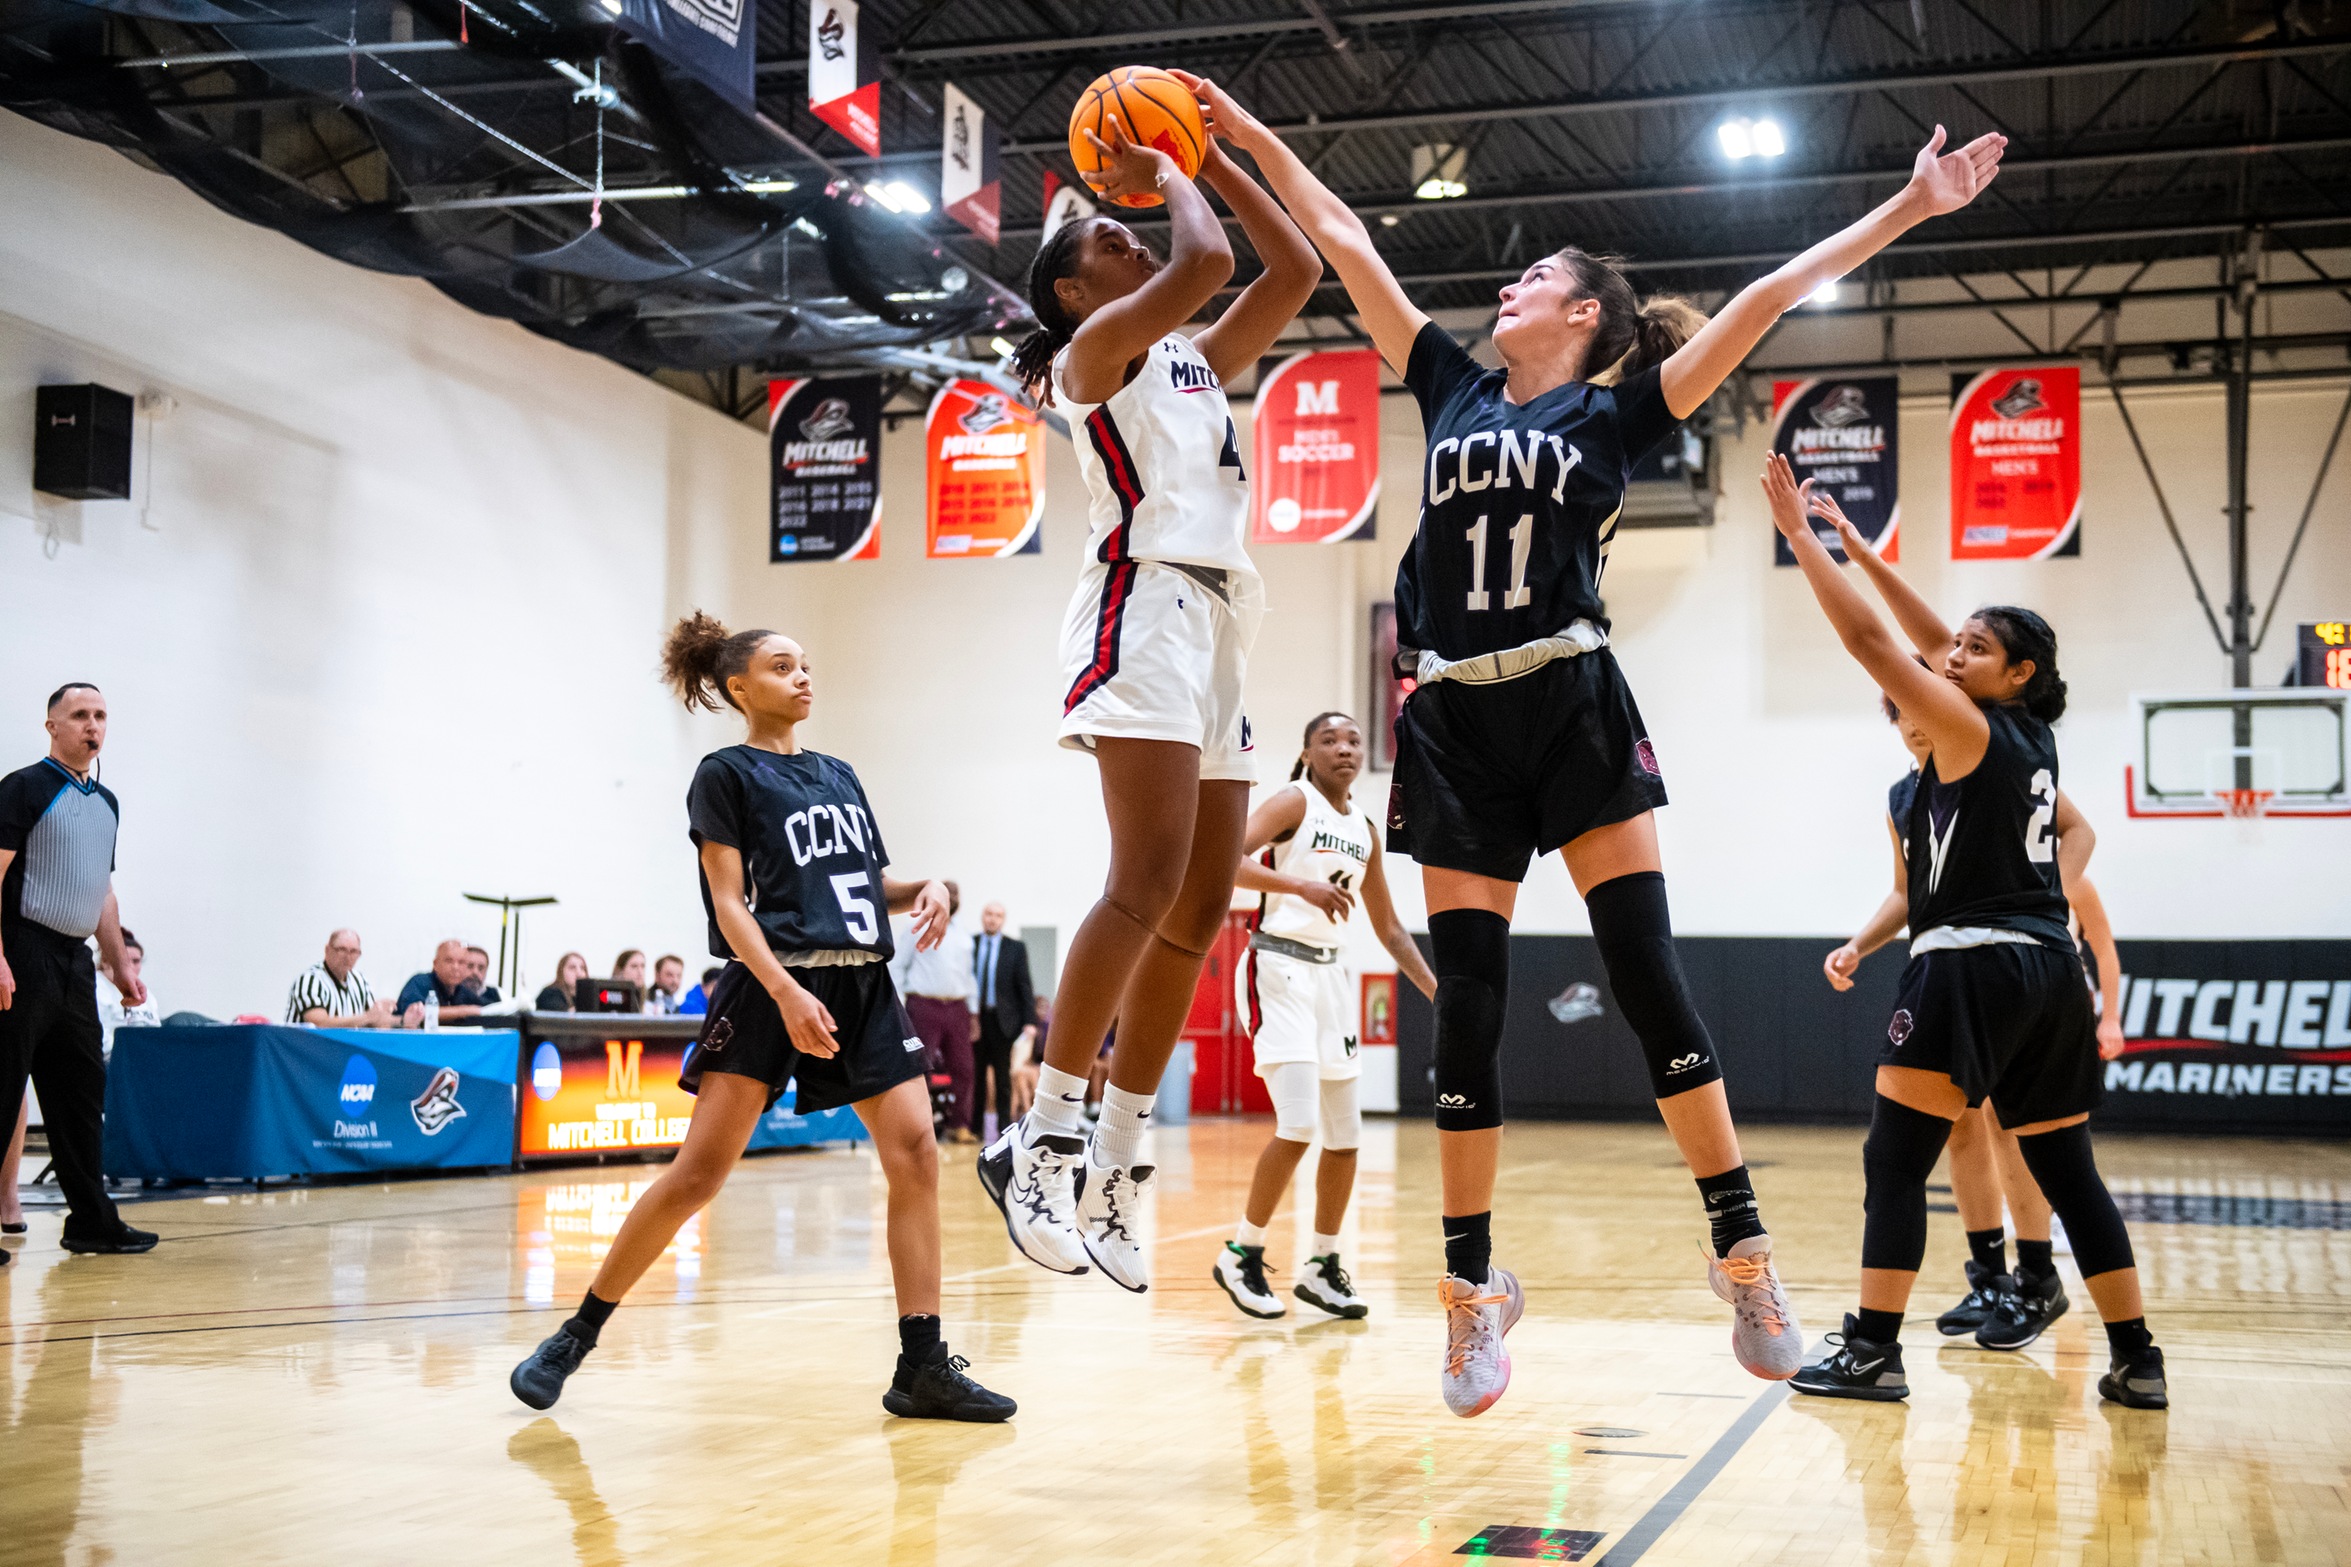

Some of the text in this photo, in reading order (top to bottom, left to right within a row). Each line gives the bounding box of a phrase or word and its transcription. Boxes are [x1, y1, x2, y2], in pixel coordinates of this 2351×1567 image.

[1295, 380, 1341, 415] M
[940, 433, 1027, 461] MITCHELL
[1791, 426, 1885, 455] MITCHELL
[1970, 418, 2064, 446] MITCHELL
[783, 439, 867, 467] MITCHELL
[1429, 429, 1582, 506] CCNY
[1466, 514, 1533, 611] 11
[829, 870, 879, 945] 5
[605, 1040, 643, 1099] M
[334, 1120, 369, 1139] Division
[548, 1117, 692, 1150] MITCHELL COLLEG
